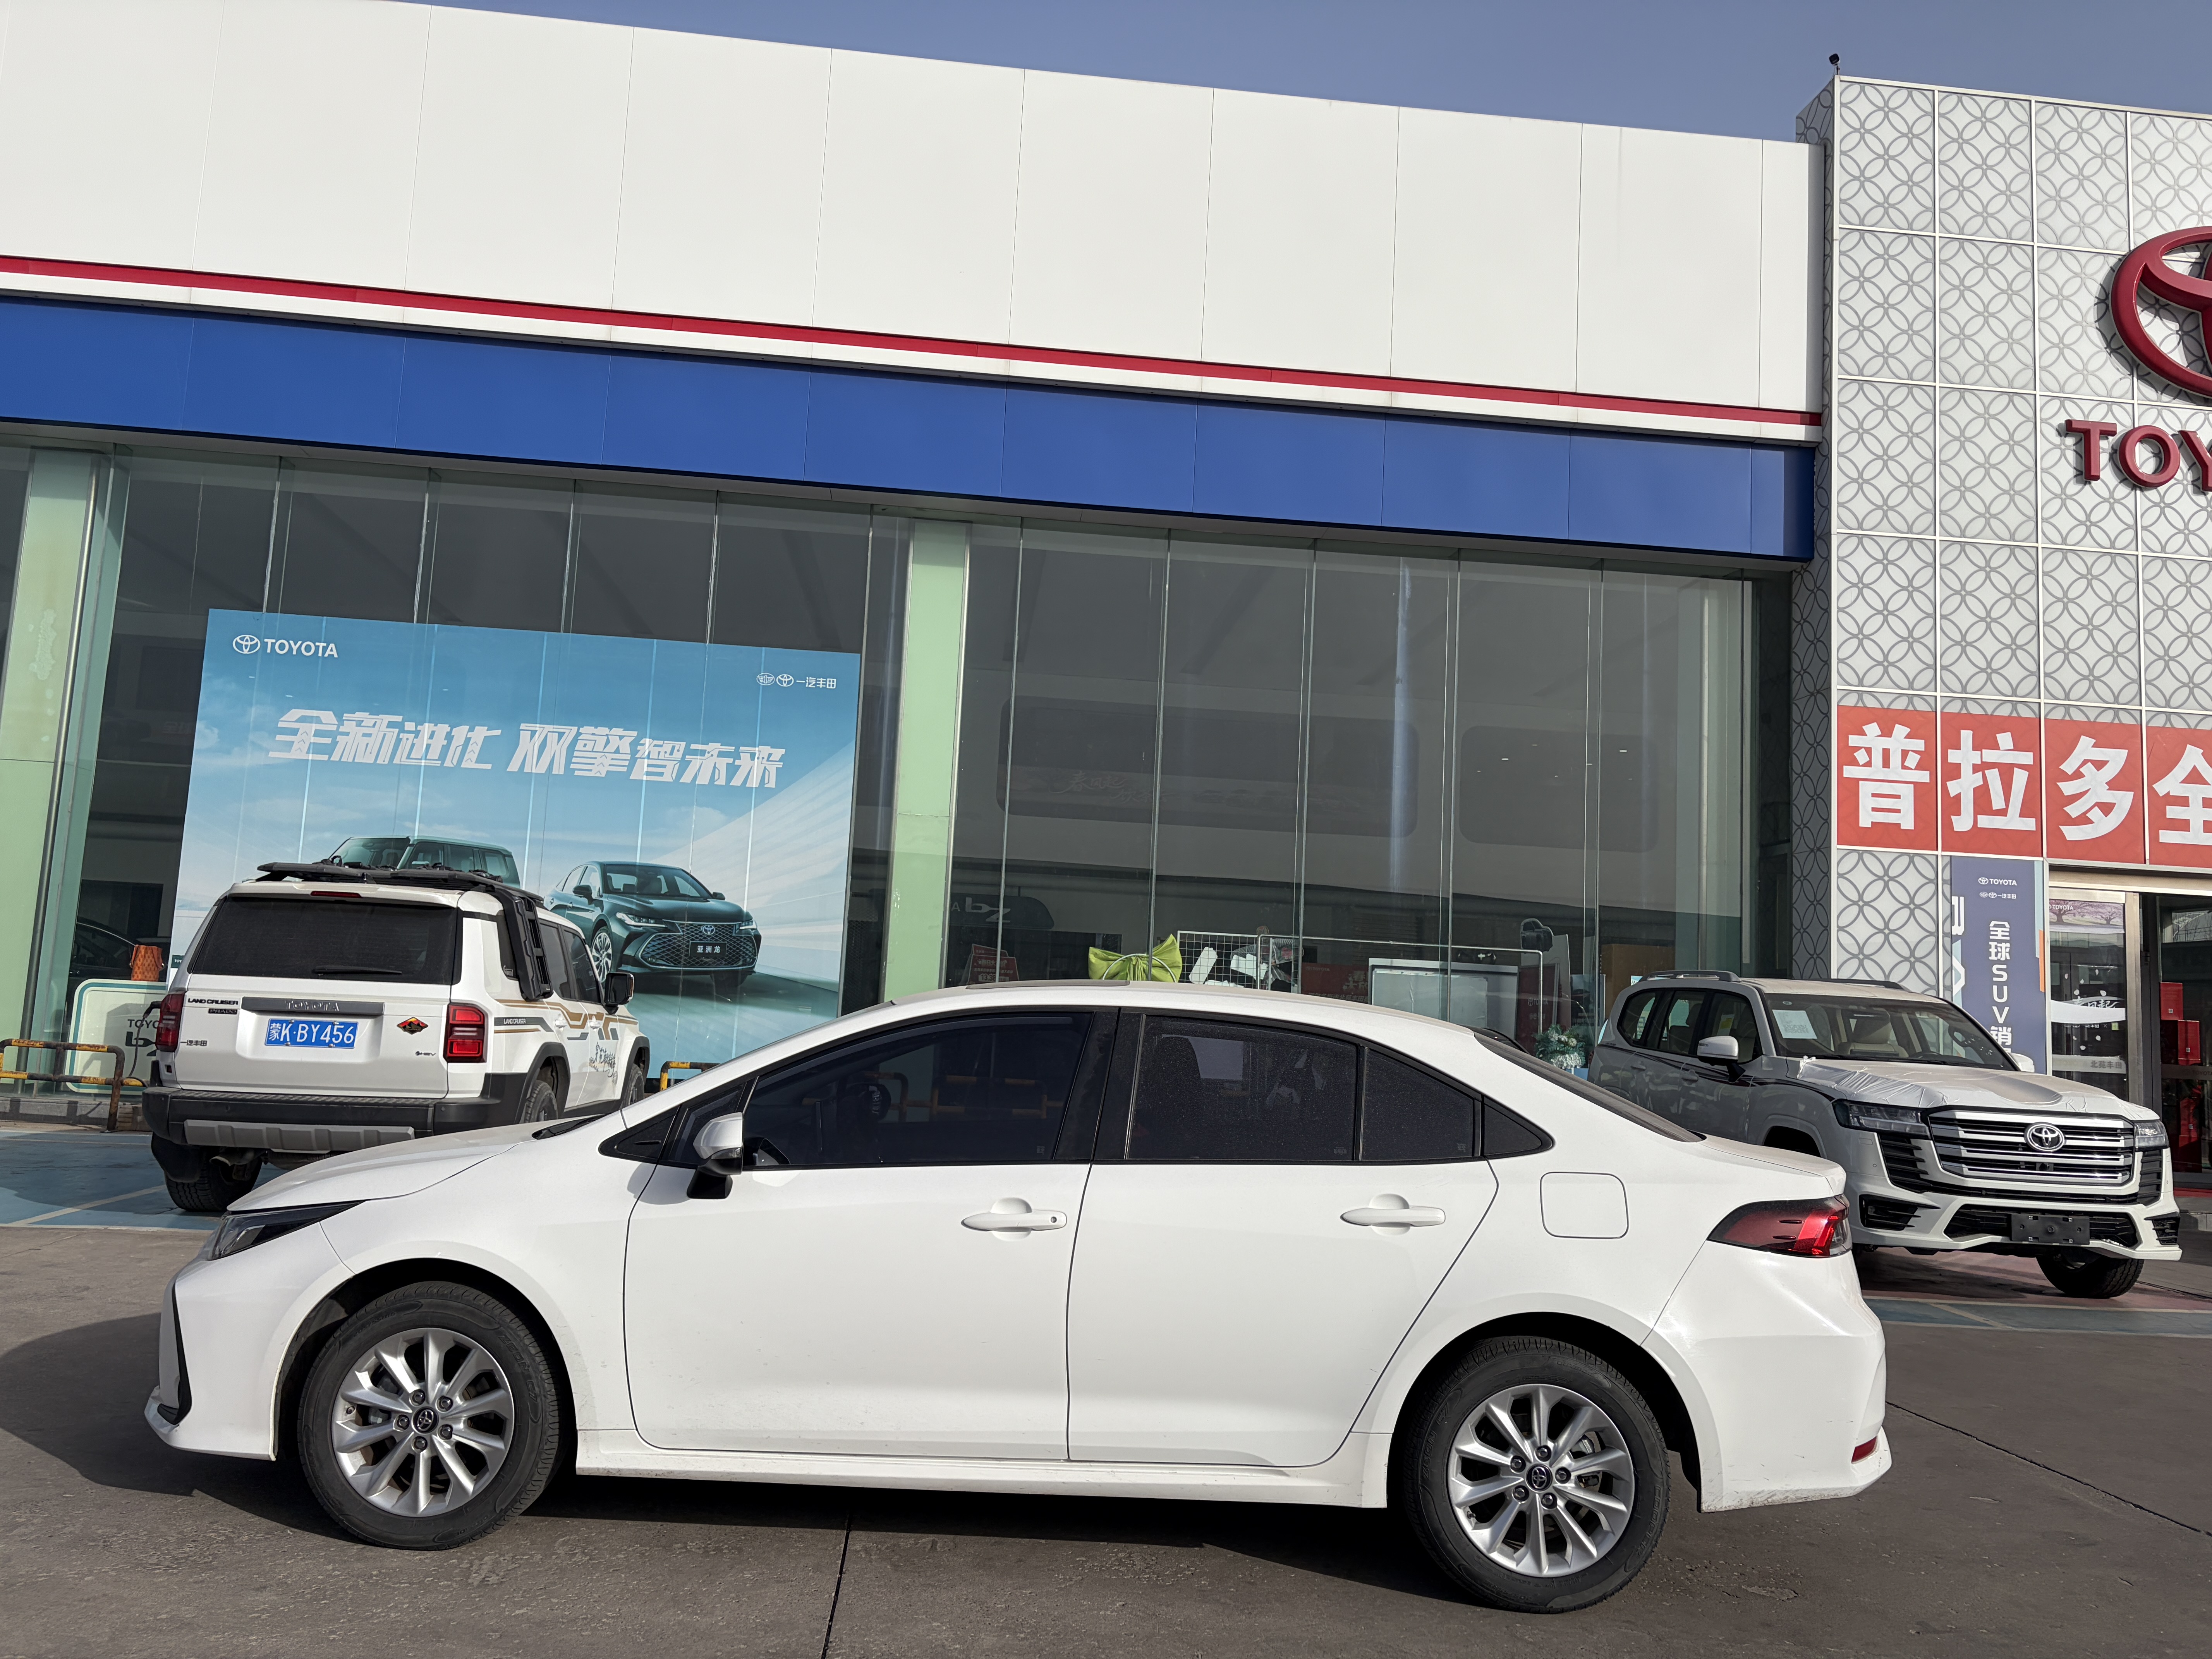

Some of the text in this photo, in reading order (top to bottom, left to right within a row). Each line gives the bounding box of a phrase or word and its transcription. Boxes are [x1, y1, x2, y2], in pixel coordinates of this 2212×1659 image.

[264, 639, 338, 658] TOYOTA
[796, 677, 836, 689] 一汽丰田
[268, 709, 785, 788] 全新进化 双擎智未来
[1843, 722, 2212, 845] 普拉多全
[285, 1000, 340, 1012] TOYOTA
[1989, 921, 2012, 1053] 全球SUV销
[2090, 1060, 2123, 1069] 北苑丰田
[498, 1334, 530, 1374] ZEON
[1422, 1429, 1437, 1480] ZEON
